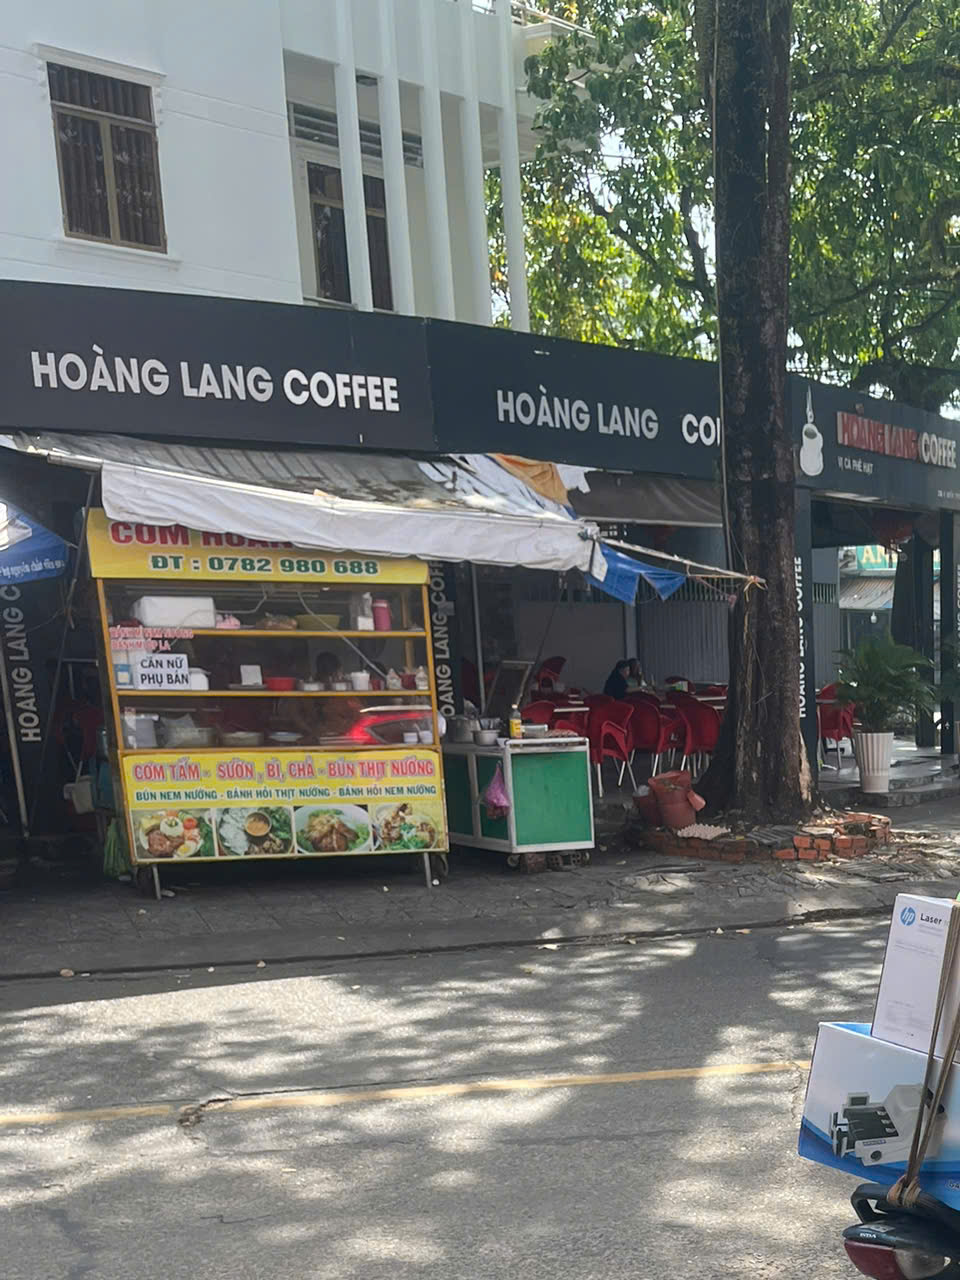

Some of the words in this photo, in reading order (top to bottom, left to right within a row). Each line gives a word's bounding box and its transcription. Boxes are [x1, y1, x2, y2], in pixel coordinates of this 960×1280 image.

[31, 344, 169, 395] HOÀNG
[180, 361, 273, 402] LANG
[283, 369, 400, 411] COFFEE
[496, 385, 590, 431] HOÀNG
[597, 403, 658, 439] LANG
[681, 413, 721, 447] CO
[921, 432, 957, 469] COFFEE
[151, 555, 183, 570] ĐT
[208, 556, 272, 573] 0782
[280, 558, 326, 573] 980
[333, 559, 379, 575] 688
[2, 607, 30, 661] LANG
[140, 673, 163, 687] PHỤ
[436, 663, 457, 720] OANG
[133, 761, 165, 781] CƠM
[168, 756, 200, 780] TẤM
[288, 755, 315, 777] CHẢ
[328, 756, 355, 777] BÚN
[357, 761, 386, 781] THỊT
[391, 756, 434, 777] NƯỚNG
[136, 789, 157, 801] BÚN
[160, 791, 182, 800] NEM
[184, 787, 218, 800] NƯỚNG
[226, 786, 253, 799] BÁNH
[275, 785, 295, 799] THỊT
[299, 785, 330, 797] NƯỚNG
[338, 786, 364, 797] BÁNH
[384, 786, 404, 796] NEM
[406, 784, 437, 795] NƯỚNG
[920, 913, 942, 925] Laser
